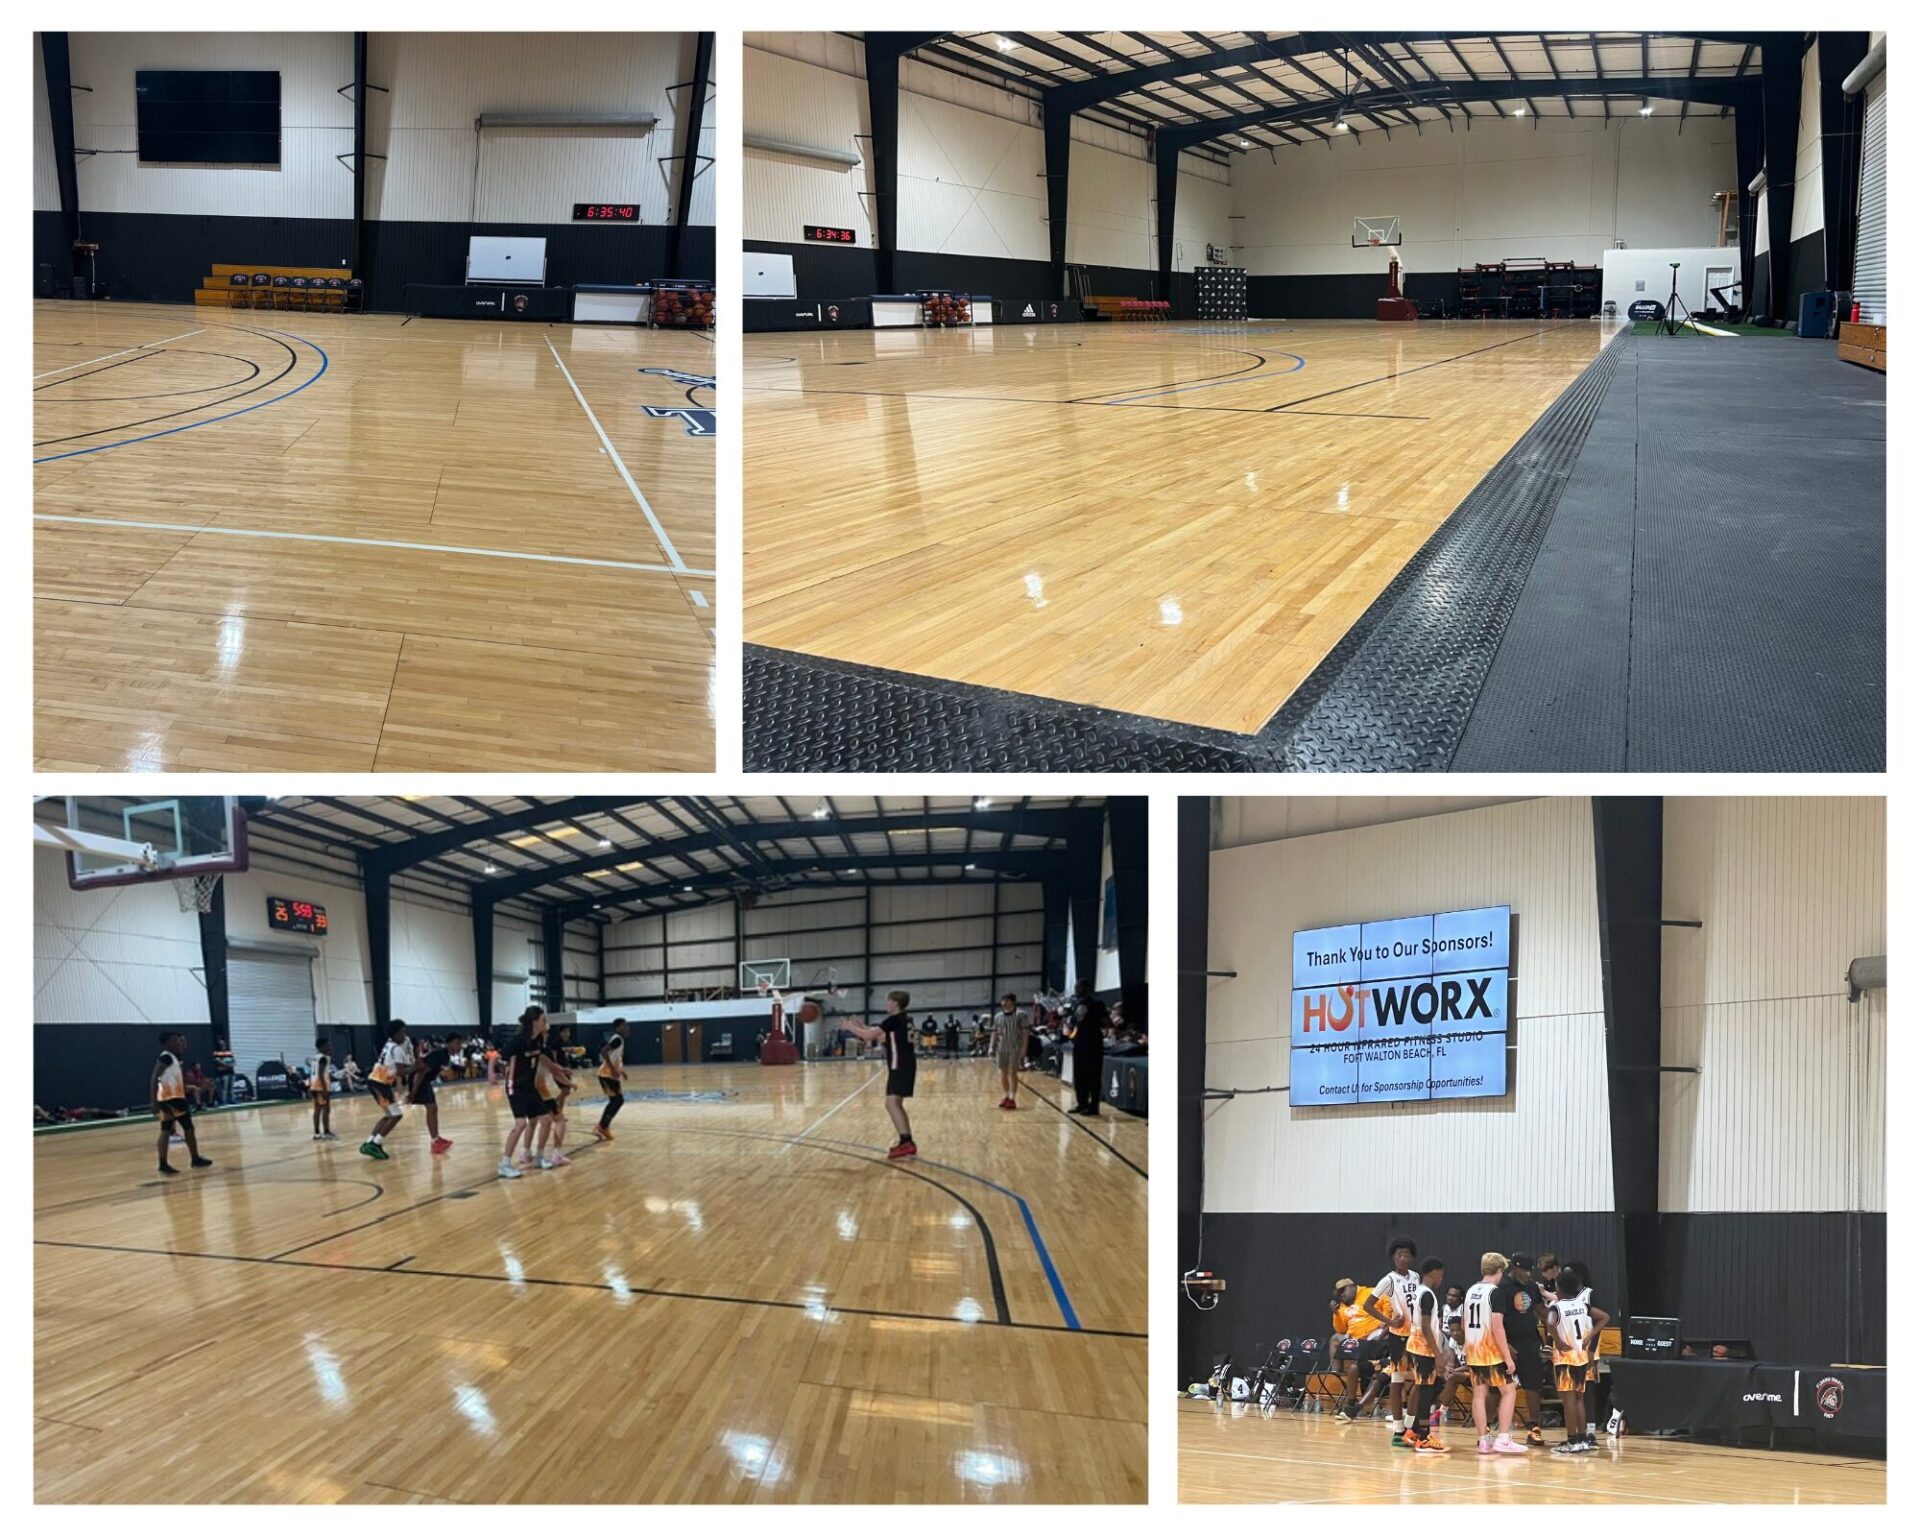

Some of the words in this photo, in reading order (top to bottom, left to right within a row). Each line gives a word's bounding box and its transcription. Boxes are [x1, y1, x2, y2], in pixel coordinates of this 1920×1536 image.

[587, 206, 633, 218] 6:35:40
[816, 228, 851, 241] 6:34:36
[1307, 948, 1347, 967] Thank
[1349, 945, 1372, 962] You
[1376, 944, 1390, 960] to
[1393, 940, 1418, 958] Our
[1422, 931, 1493, 954] Sponsors!
[1365, 1050, 1400, 1062] WALTON
[1437, 1046, 1447, 1057] FL
[1319, 1084, 1350, 1095] Contact
[1361, 1082, 1373, 1093] for
[1374, 1080, 1424, 1093] Sponsorship
[1426, 1075, 1484, 1090] Opportunities!
[1468, 1302, 1481, 1329] 11
[1574, 1319, 1582, 1340] 1
[1237, 1383, 1243, 1395] 4
